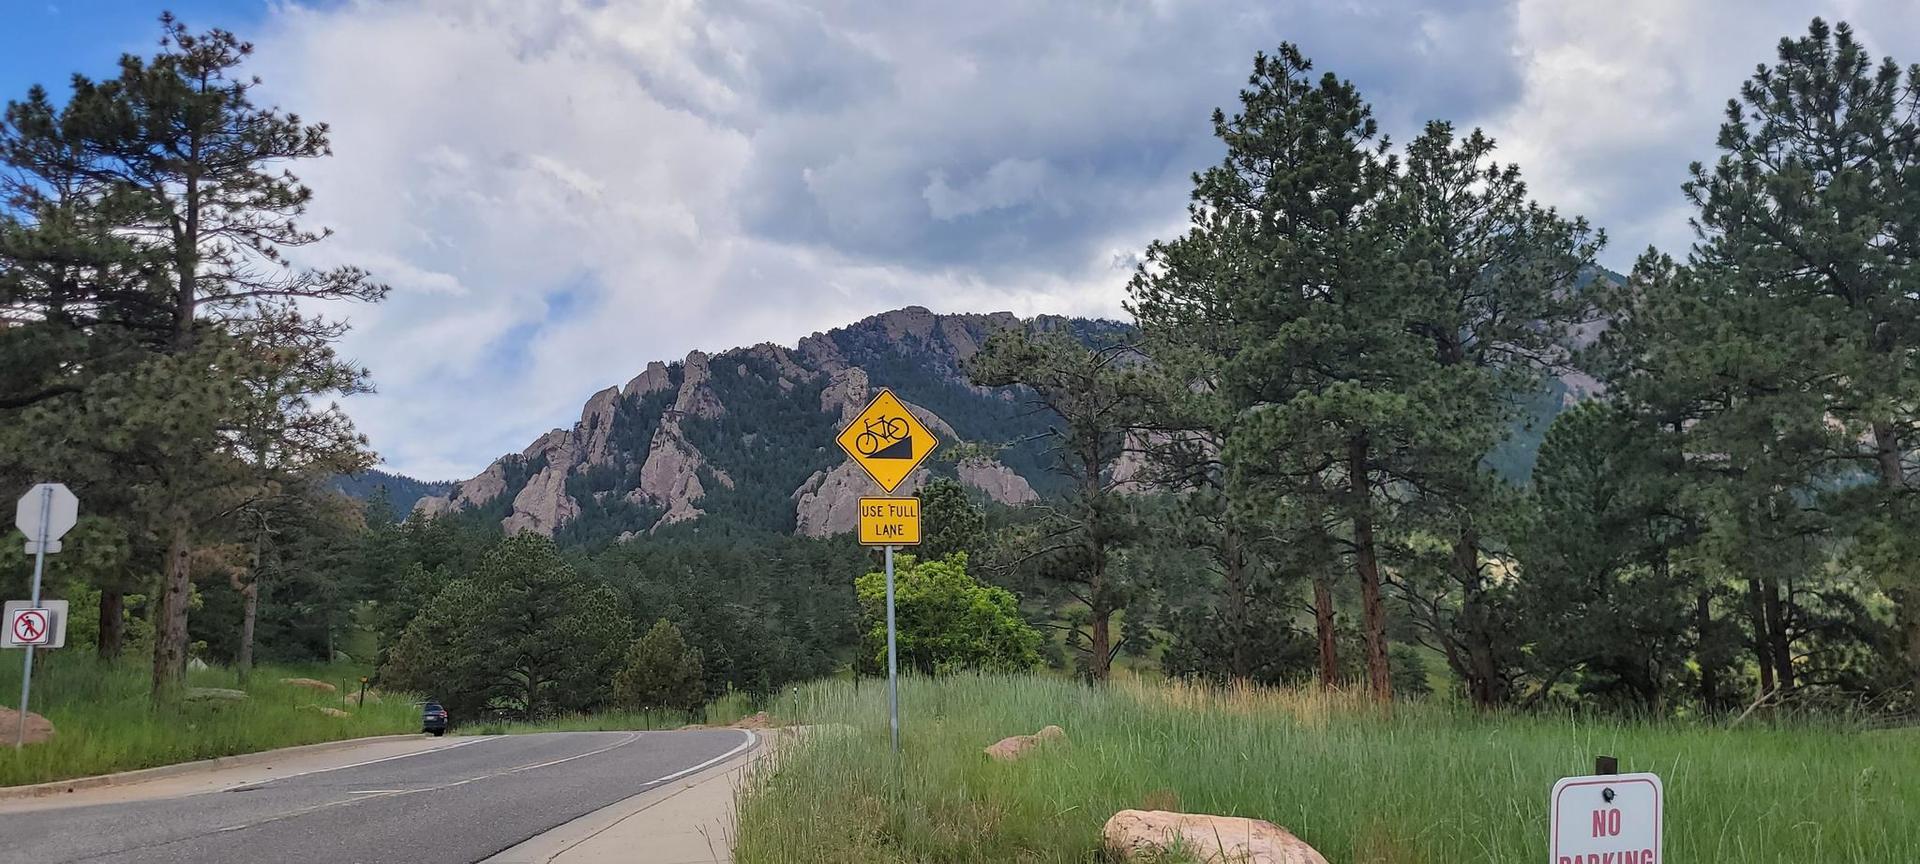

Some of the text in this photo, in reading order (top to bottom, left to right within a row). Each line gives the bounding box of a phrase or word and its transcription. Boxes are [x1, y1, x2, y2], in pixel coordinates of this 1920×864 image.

[862, 505, 917, 518] USE FULL
[875, 524, 904, 536] LANE
[1592, 808, 1621, 837] NO
